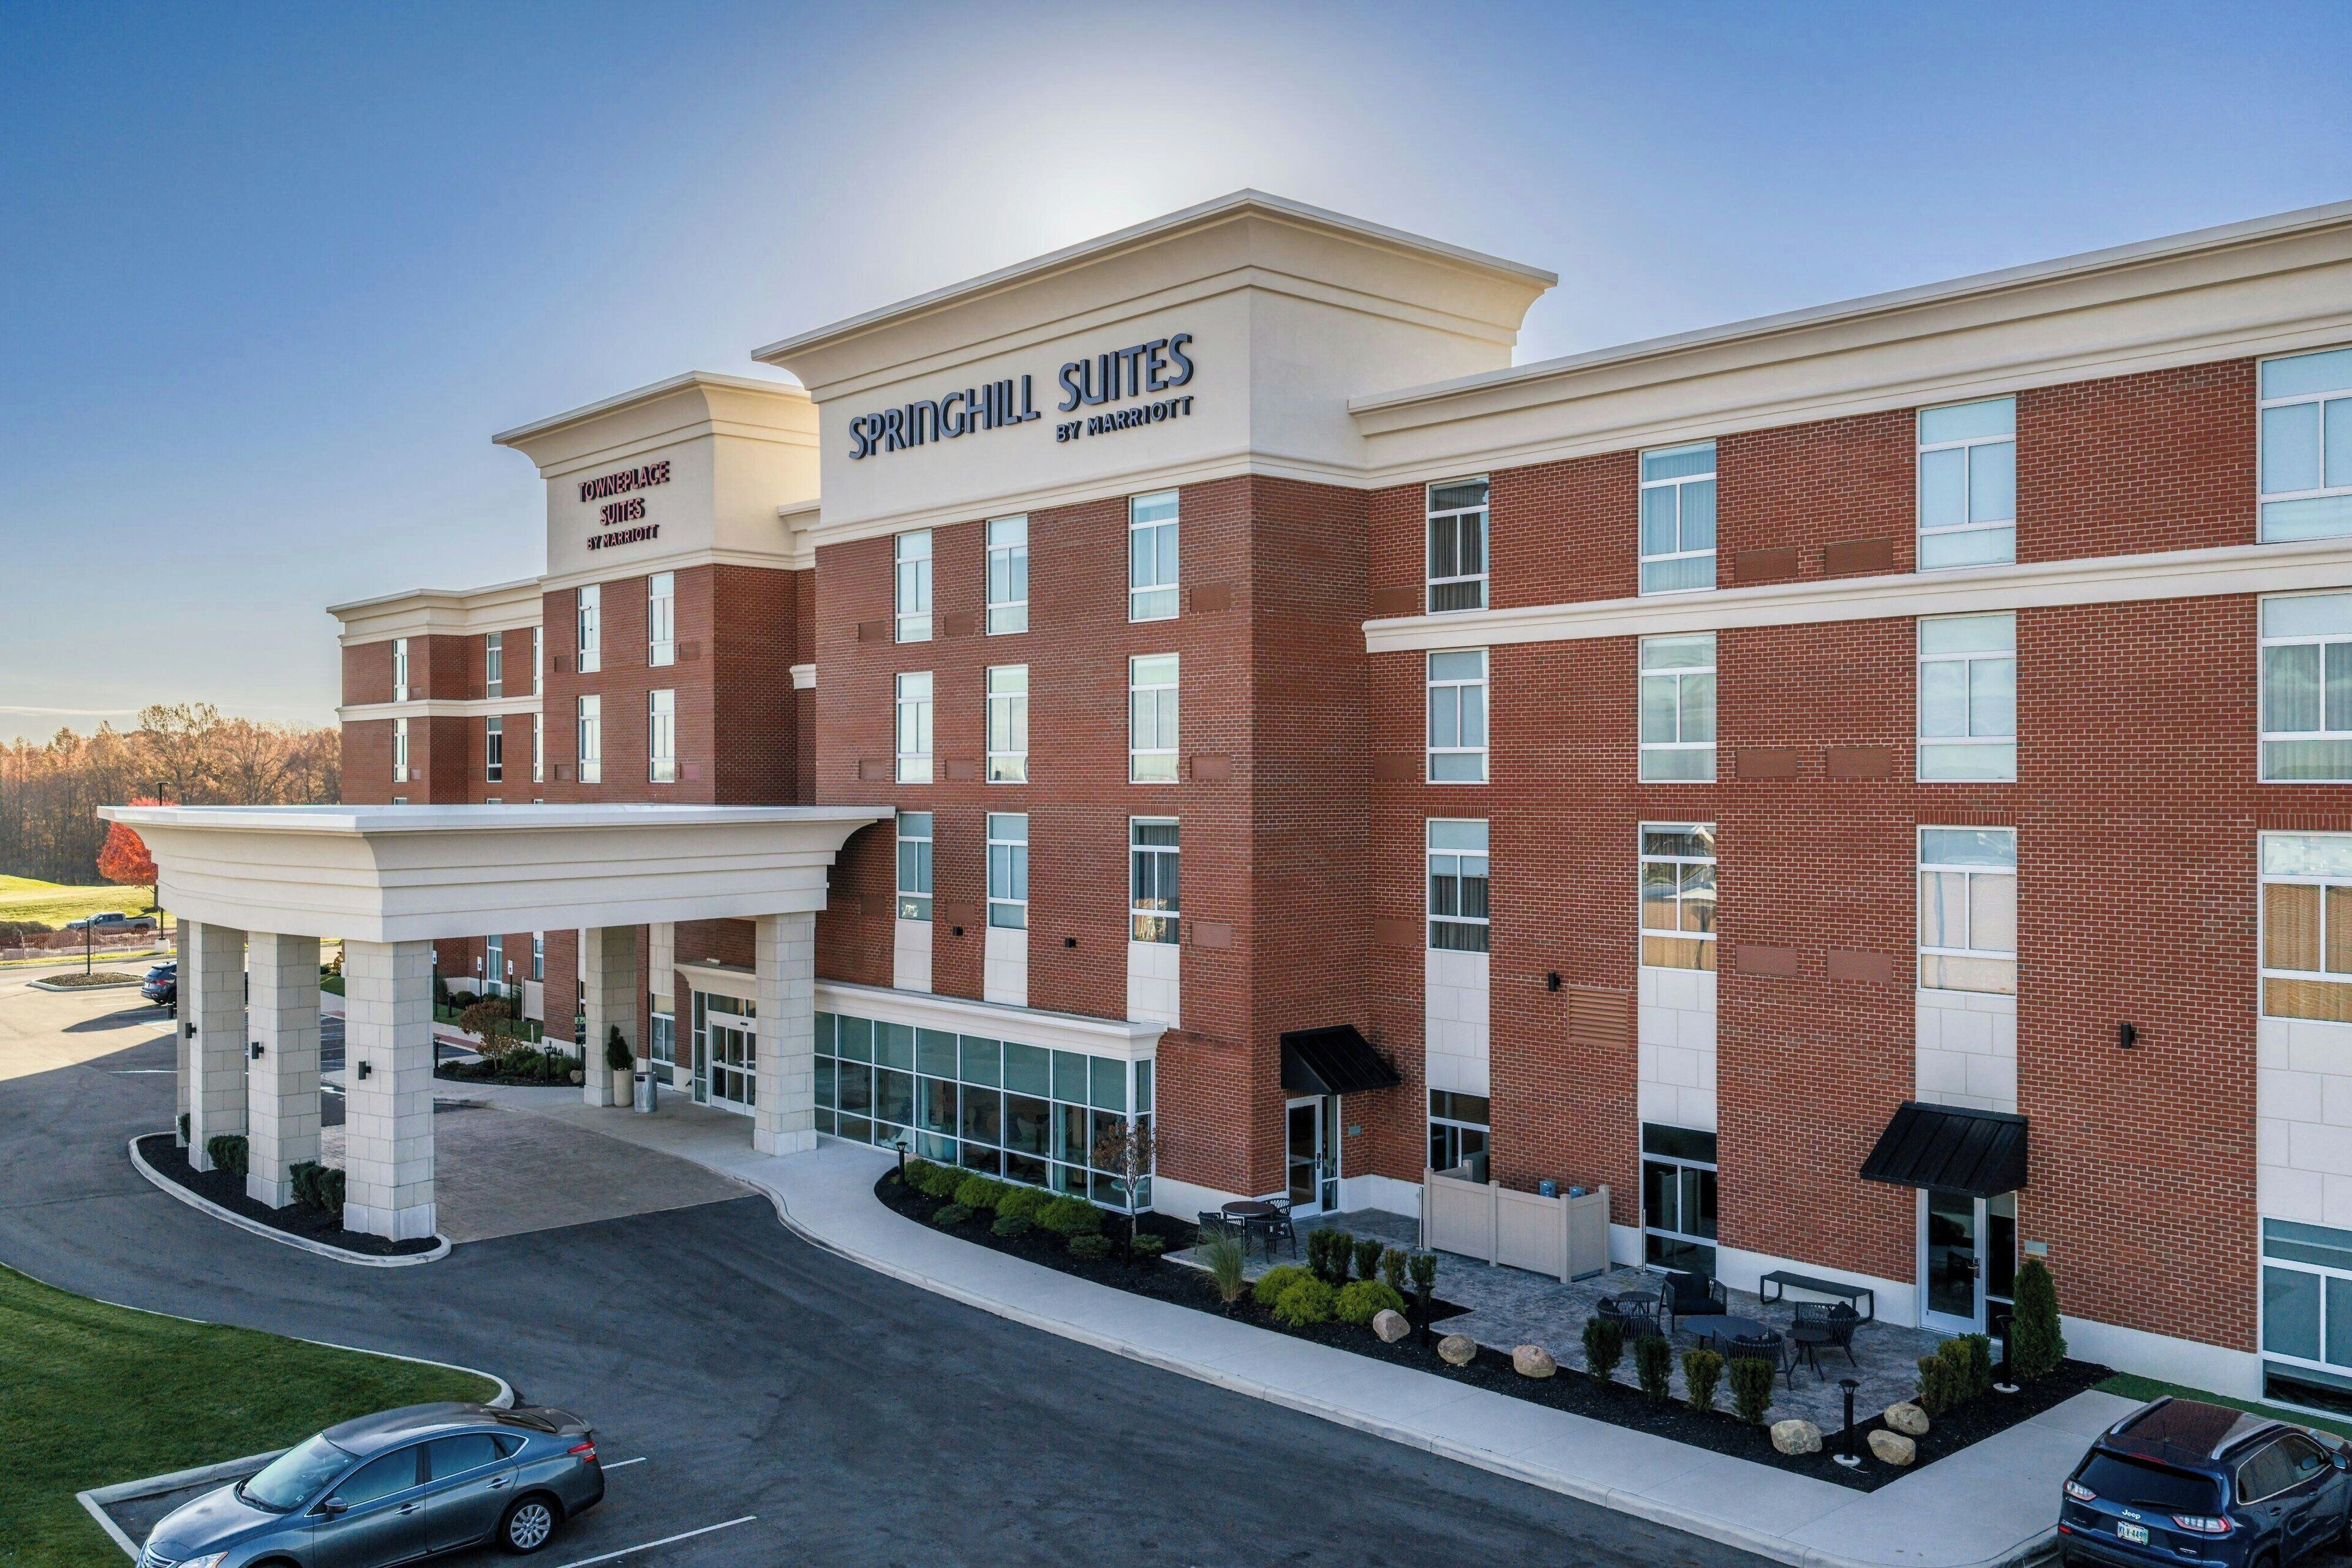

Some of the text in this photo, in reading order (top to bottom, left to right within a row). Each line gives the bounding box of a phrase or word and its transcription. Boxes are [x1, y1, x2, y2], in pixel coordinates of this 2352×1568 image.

[849, 333, 1194, 460] SPRINGHILL SUITES
[1057, 396, 1194, 443] BY MARRIOTT
[578, 461, 670, 502] TOWNEPLACE
[600, 497, 646, 526] SUITES
[587, 524, 660, 550] BY MARRIOTT
[2121, 1509, 2141, 1520] Jeep
